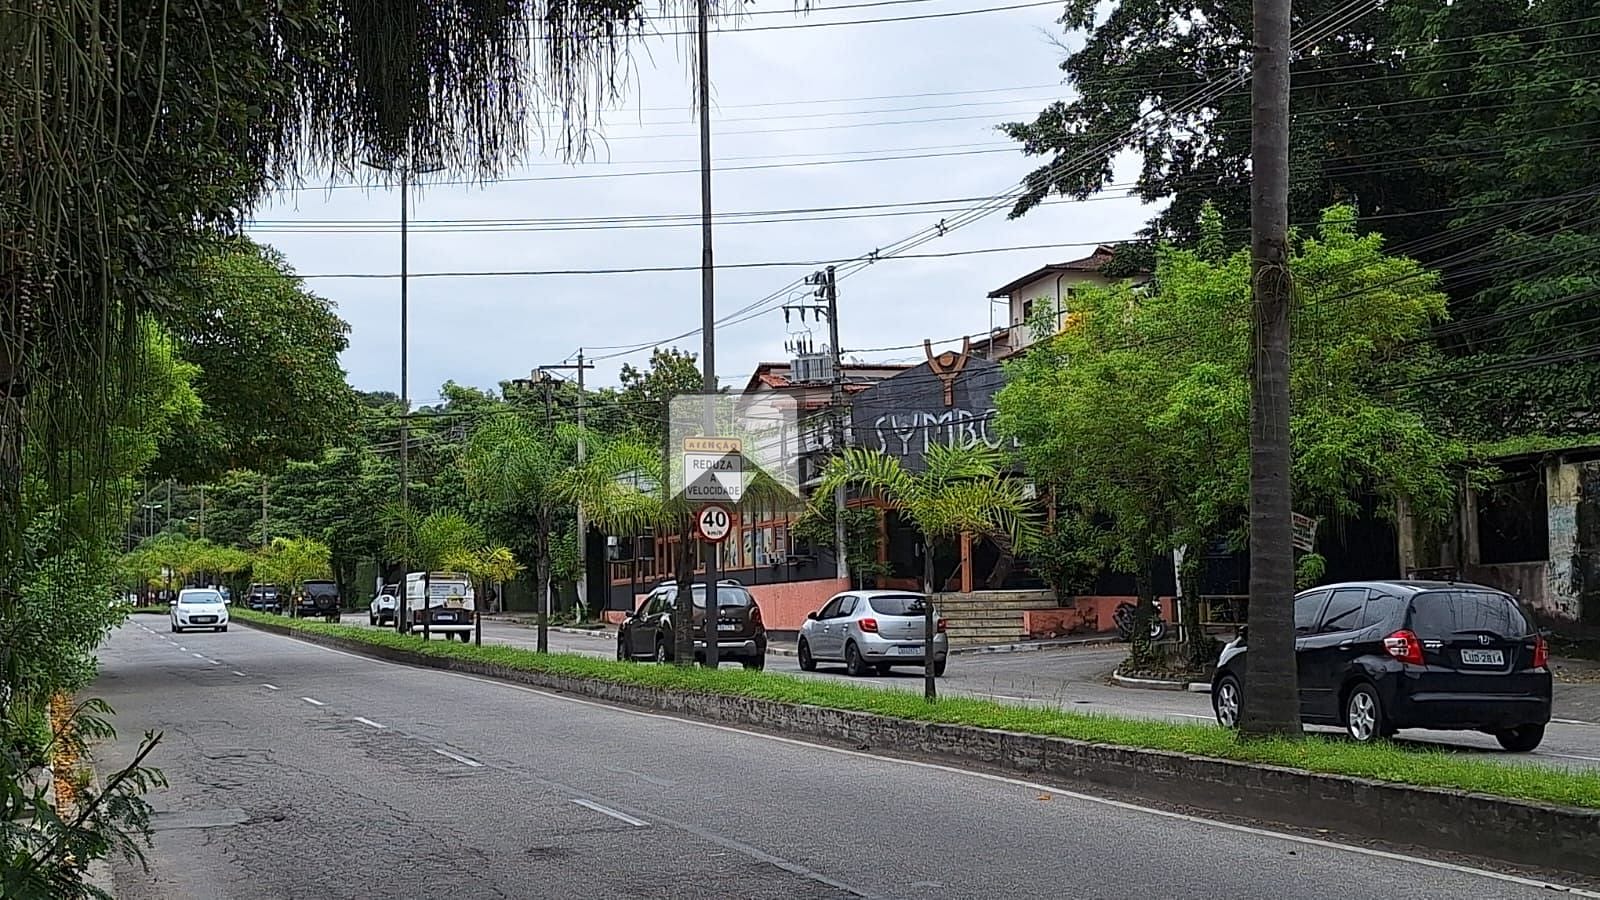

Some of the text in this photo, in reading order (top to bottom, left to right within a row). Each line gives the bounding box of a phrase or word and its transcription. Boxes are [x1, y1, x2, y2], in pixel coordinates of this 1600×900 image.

[874, 408, 1021, 456] SYMBO
[688, 440, 738, 451] ATENÇÃO
[693, 459, 733, 470] REDUZA
[710, 473, 717, 482] A
[687, 486, 741, 496] VELOCIDADE
[702, 511, 727, 528] 40
